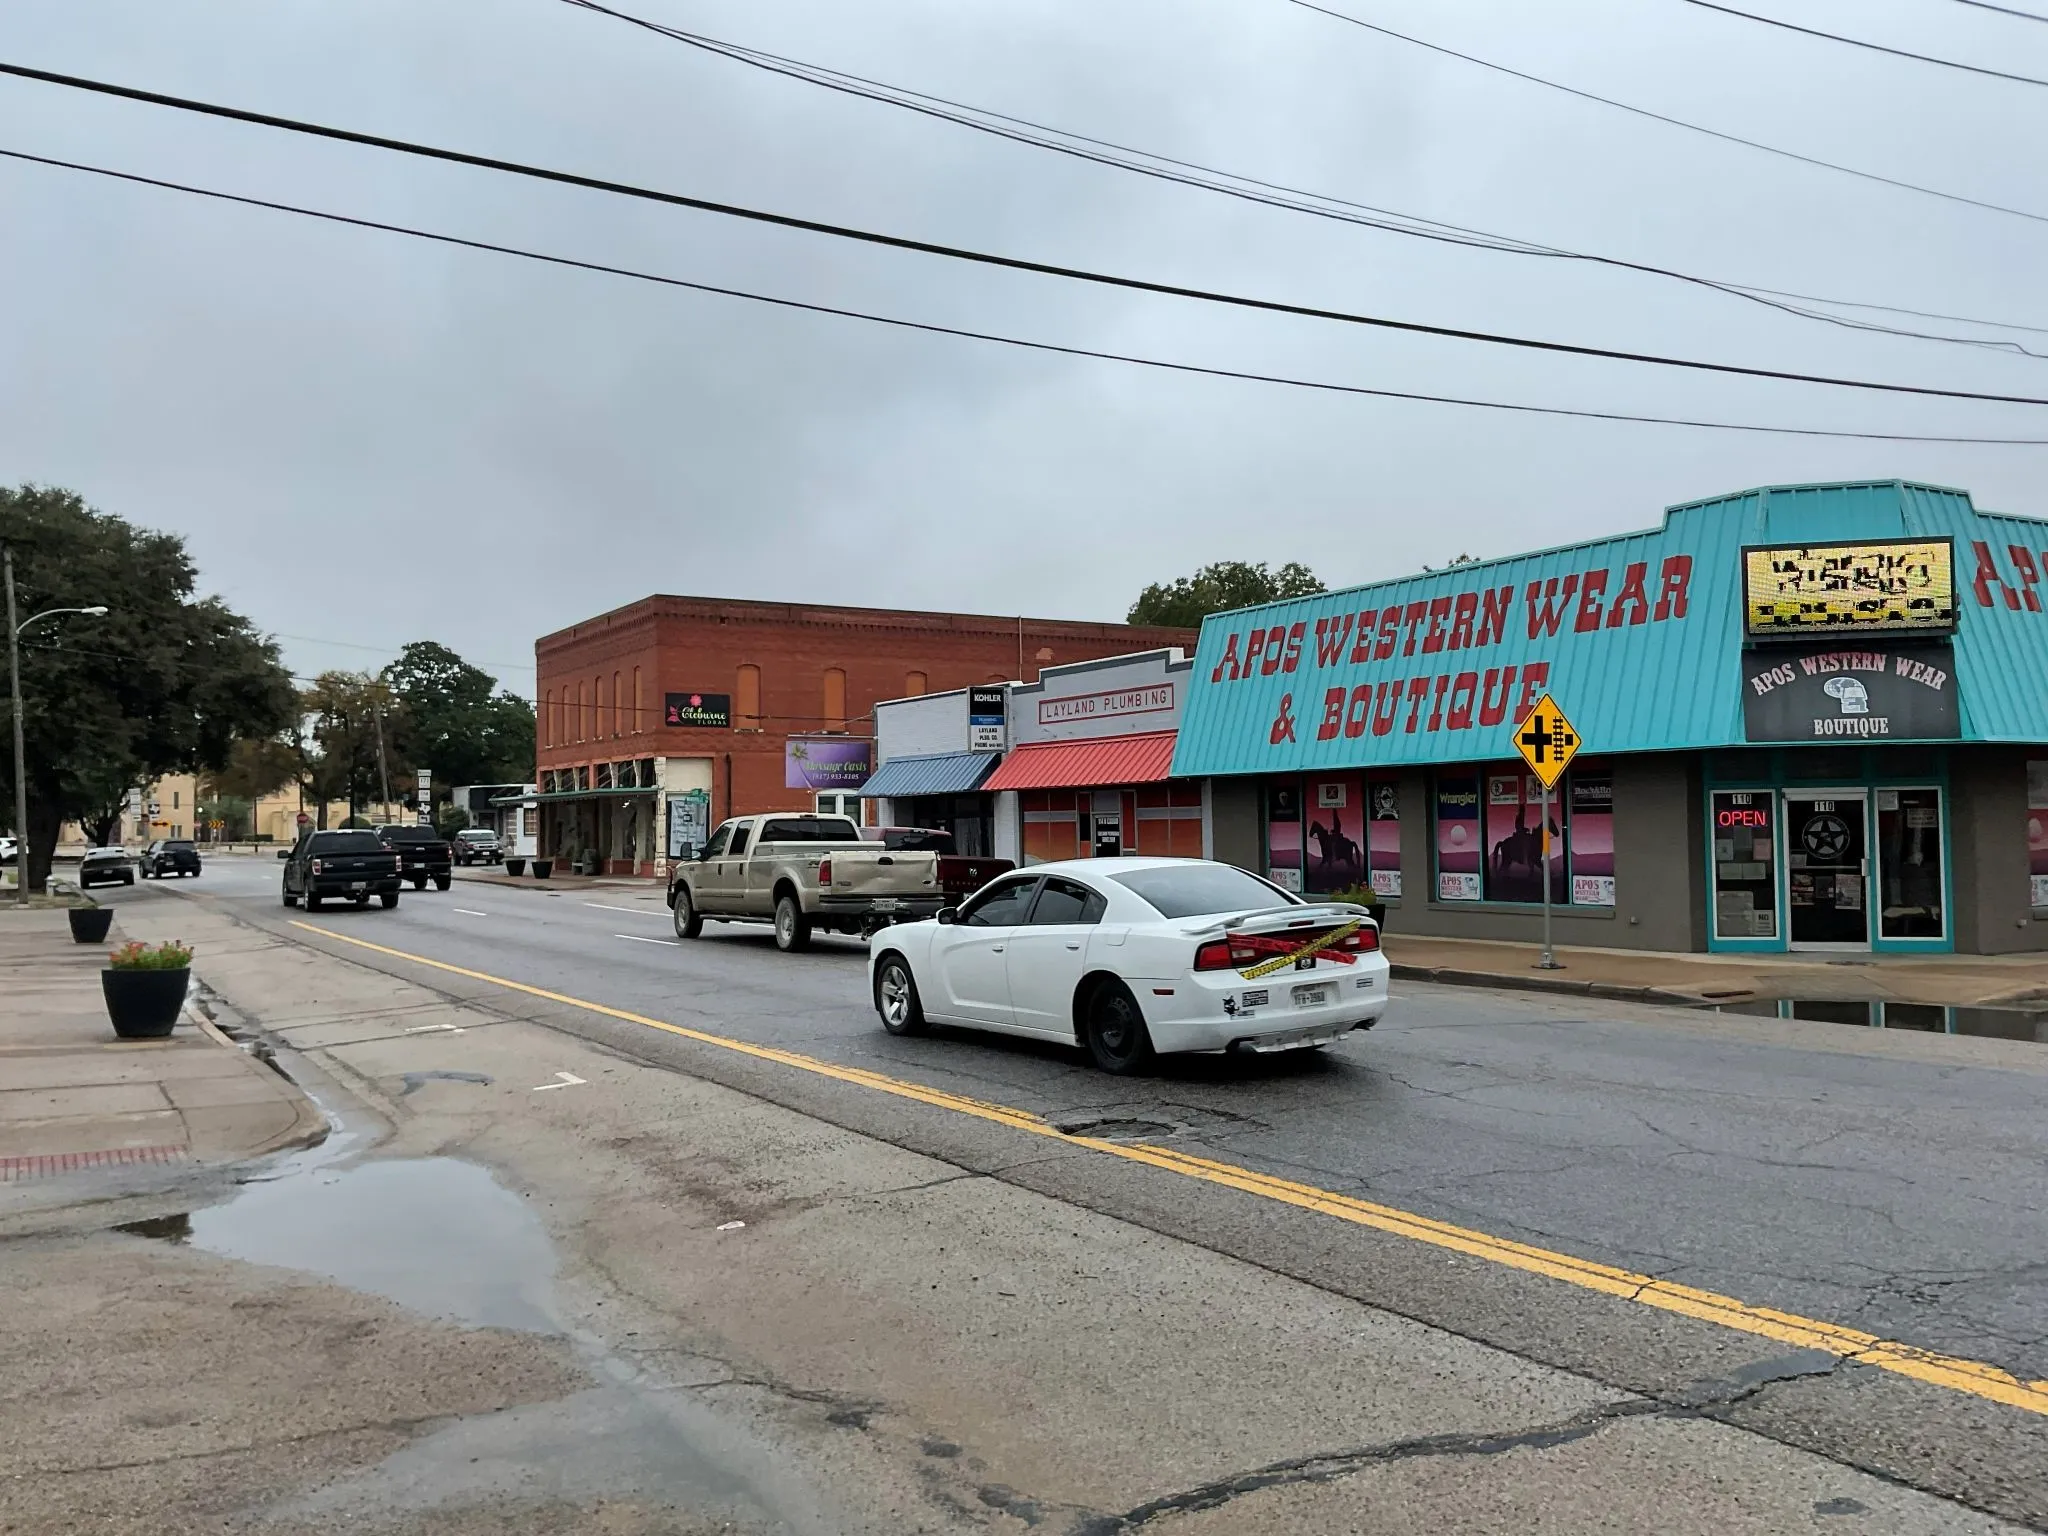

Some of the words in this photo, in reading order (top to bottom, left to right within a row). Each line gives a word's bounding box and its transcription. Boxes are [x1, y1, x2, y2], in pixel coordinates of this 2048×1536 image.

[1972, 540, 2048, 613] AP
[1211, 621, 1307, 683] APOS
[1314, 585, 1514, 669] WESTERN
[1526, 555, 1694, 641] WEAR
[1750, 663, 1797, 697] APOS
[1798, 651, 1888, 677] WESTERN
[1895, 656, 1948, 691] WEAR
[974, 693, 1002, 702] KOHLER
[1046, 699, 1096, 719] LAYLAND
[1103, 689, 1167, 711] PLUMBING
[1269, 692, 1296, 745] &
[1317, 661, 1551, 741] BOUTIQUE
[681, 706, 727, 720] Cleburne
[1813, 717, 1889, 739] BOUTIQUE
[843, 760, 867, 772] Oasis
[1439, 792, 1477, 806] Wrangler
[1734, 794, 1751, 804] 110
[1815, 802, 1834, 811] 110
[1719, 811, 1766, 826] OPEN
[1271, 871, 1287, 880] APOS
[1373, 873, 1391, 883] APOS
[1441, 876, 1462, 886] APOS
[1575, 880, 1600, 890] APOS
